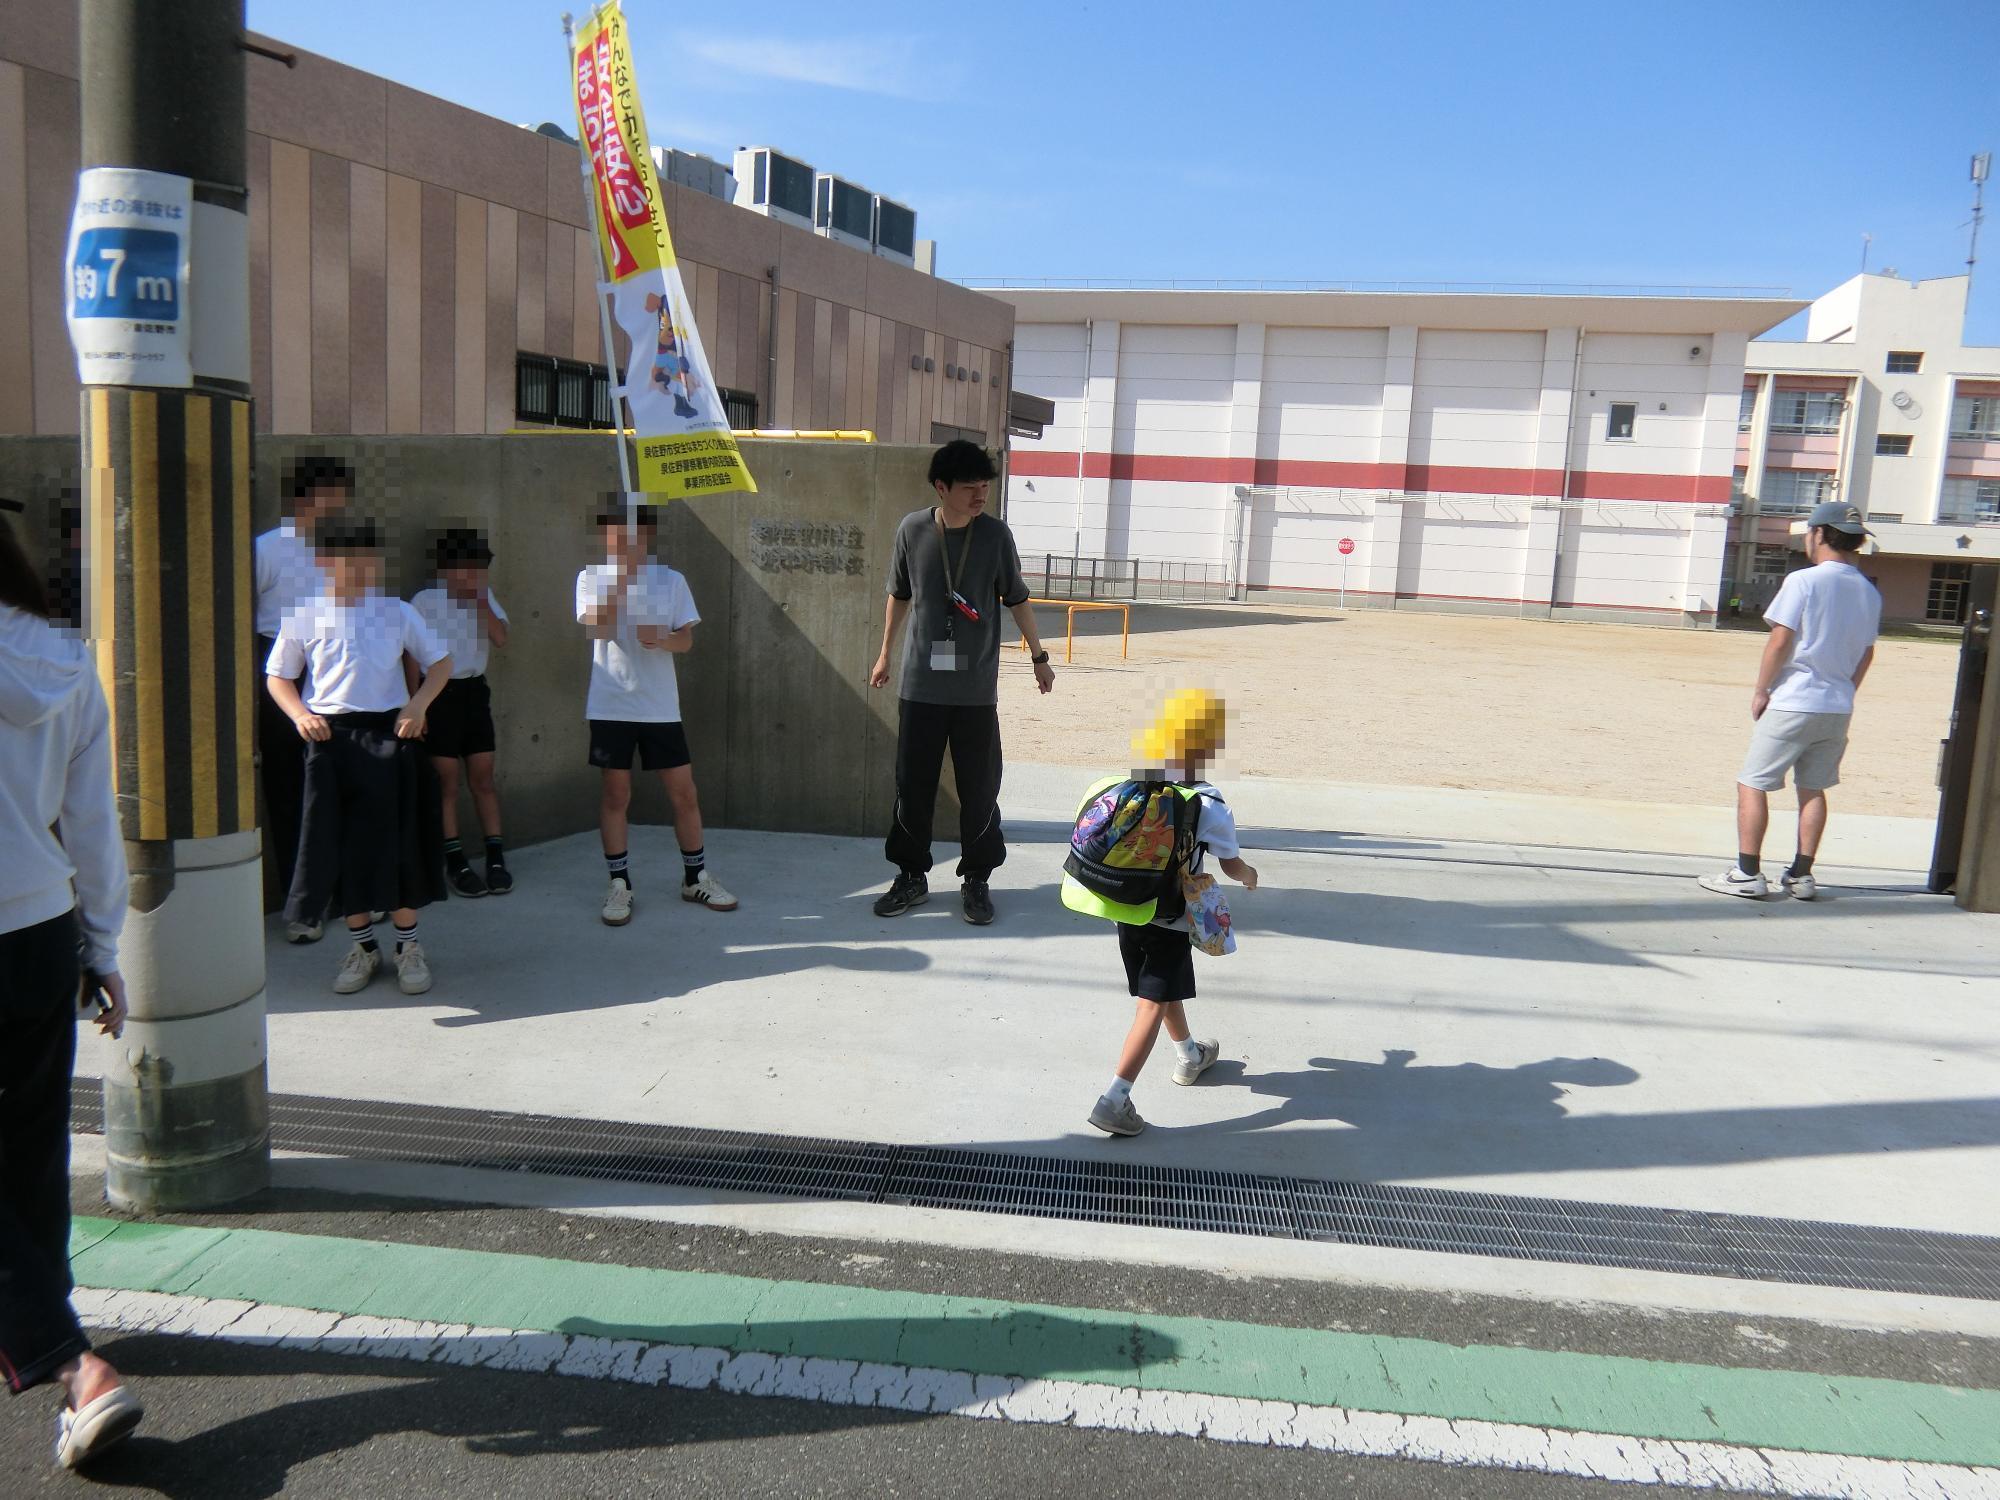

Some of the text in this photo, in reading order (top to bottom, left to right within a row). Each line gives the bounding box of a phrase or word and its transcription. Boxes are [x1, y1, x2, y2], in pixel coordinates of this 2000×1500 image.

[684, 472, 732, 490] 事業所防犯協会
